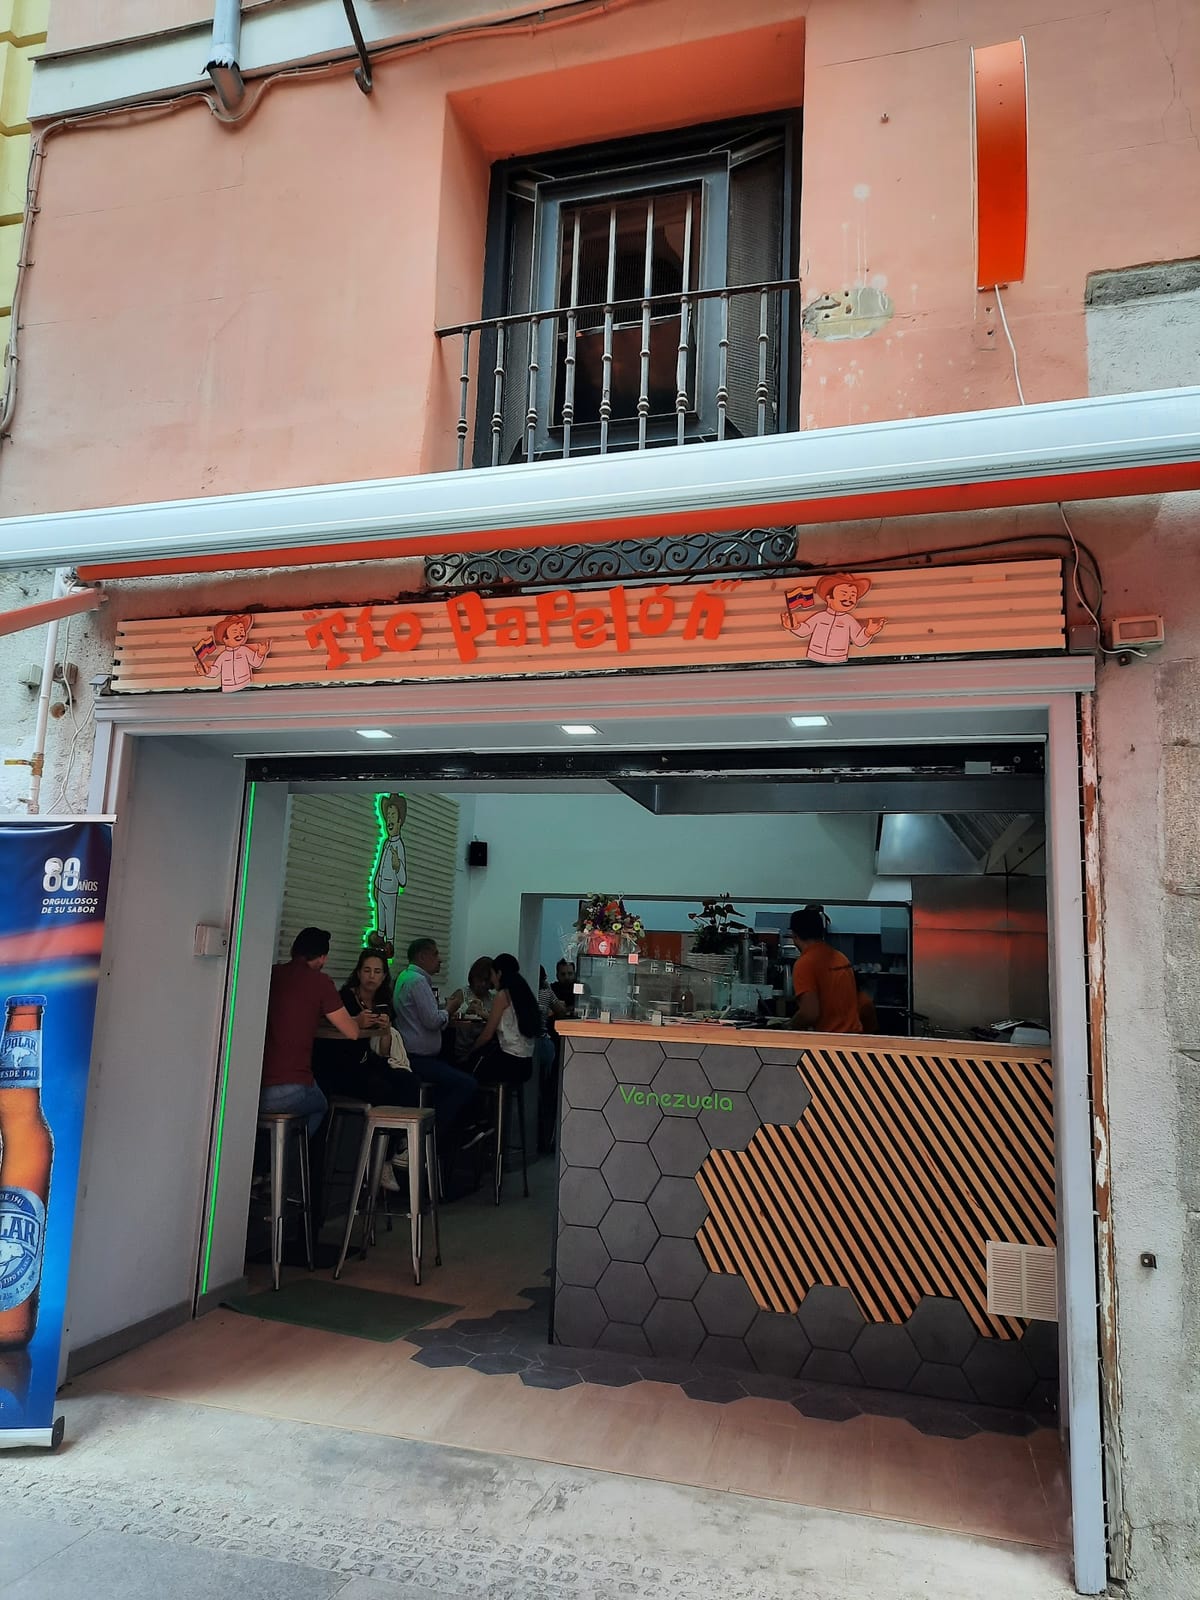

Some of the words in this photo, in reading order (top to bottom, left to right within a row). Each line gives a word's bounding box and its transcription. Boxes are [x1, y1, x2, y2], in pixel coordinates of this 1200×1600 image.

[43, 857, 81, 892] 80
[77, 880, 98, 891] AÑOS
[41, 906, 53, 914] DE
[3, 1036, 38, 1054] POLAR
[619, 1085, 733, 1111] Venezuela
